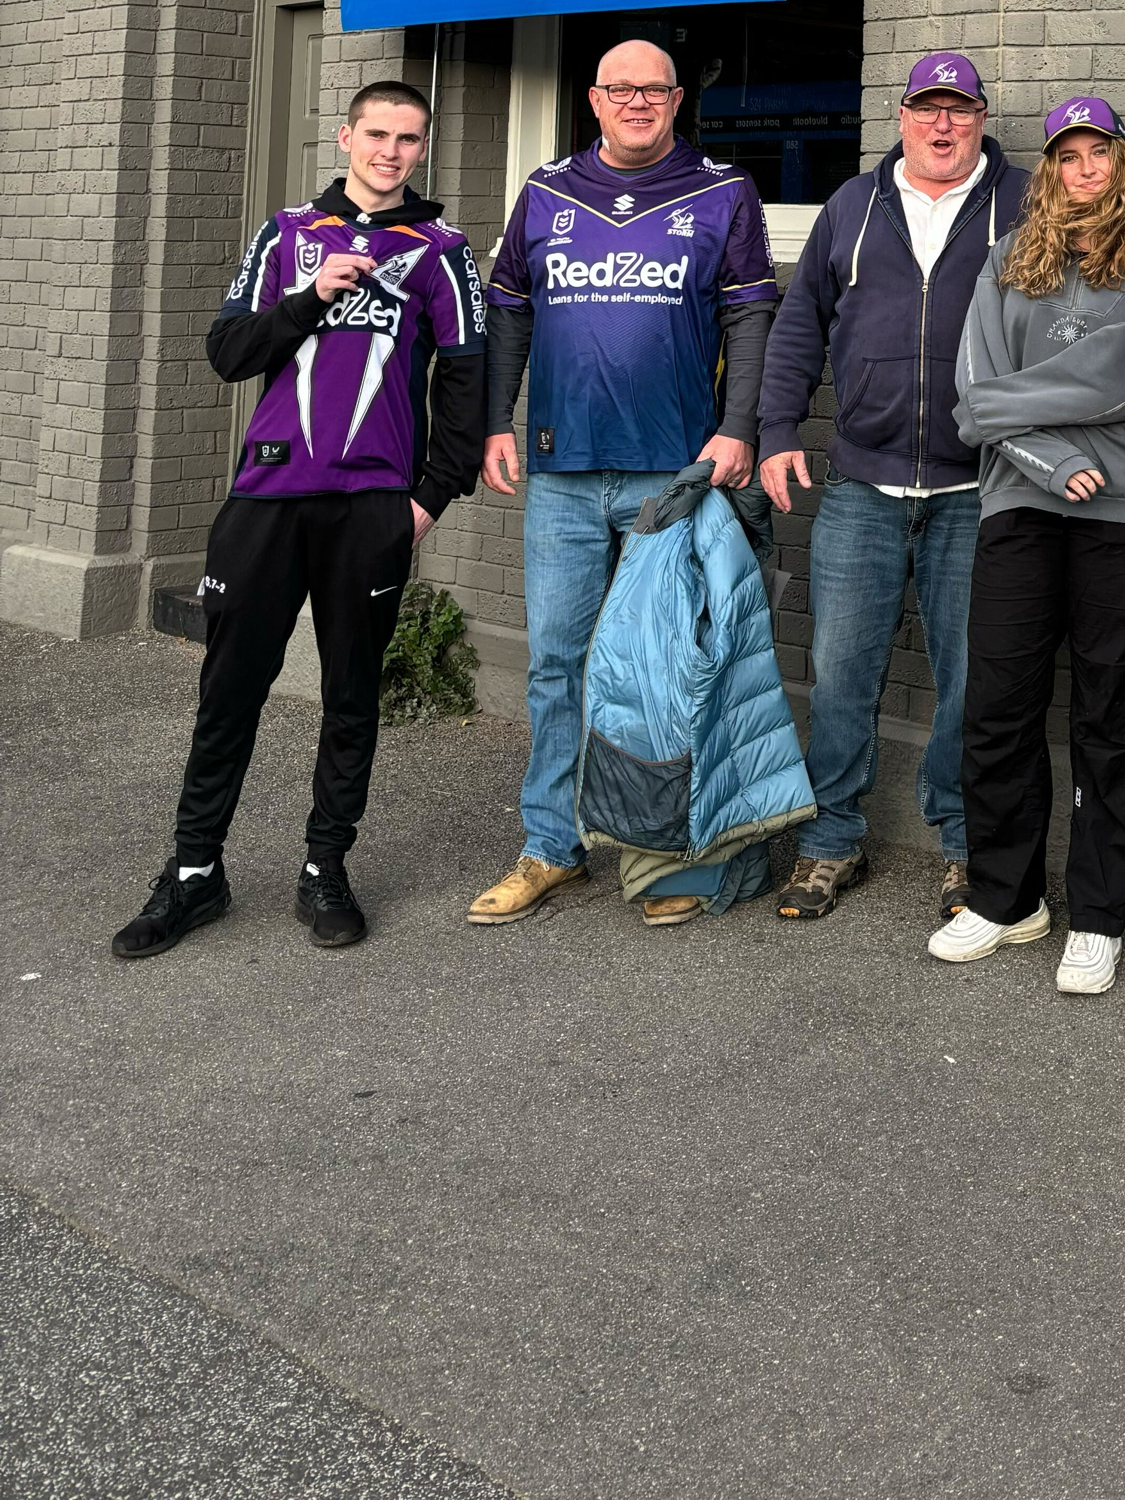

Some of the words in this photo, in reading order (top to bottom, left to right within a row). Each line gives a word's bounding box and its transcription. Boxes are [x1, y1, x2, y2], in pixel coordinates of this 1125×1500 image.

[667, 228, 695, 238] STORM
[545, 252, 689, 290] RedZed
[463, 245, 486, 334] carsales
[548, 295, 573, 305] Loans
[574, 293, 589, 303] for
[591, 292, 609, 303] the
[610, 292, 683, 306] self-employed
